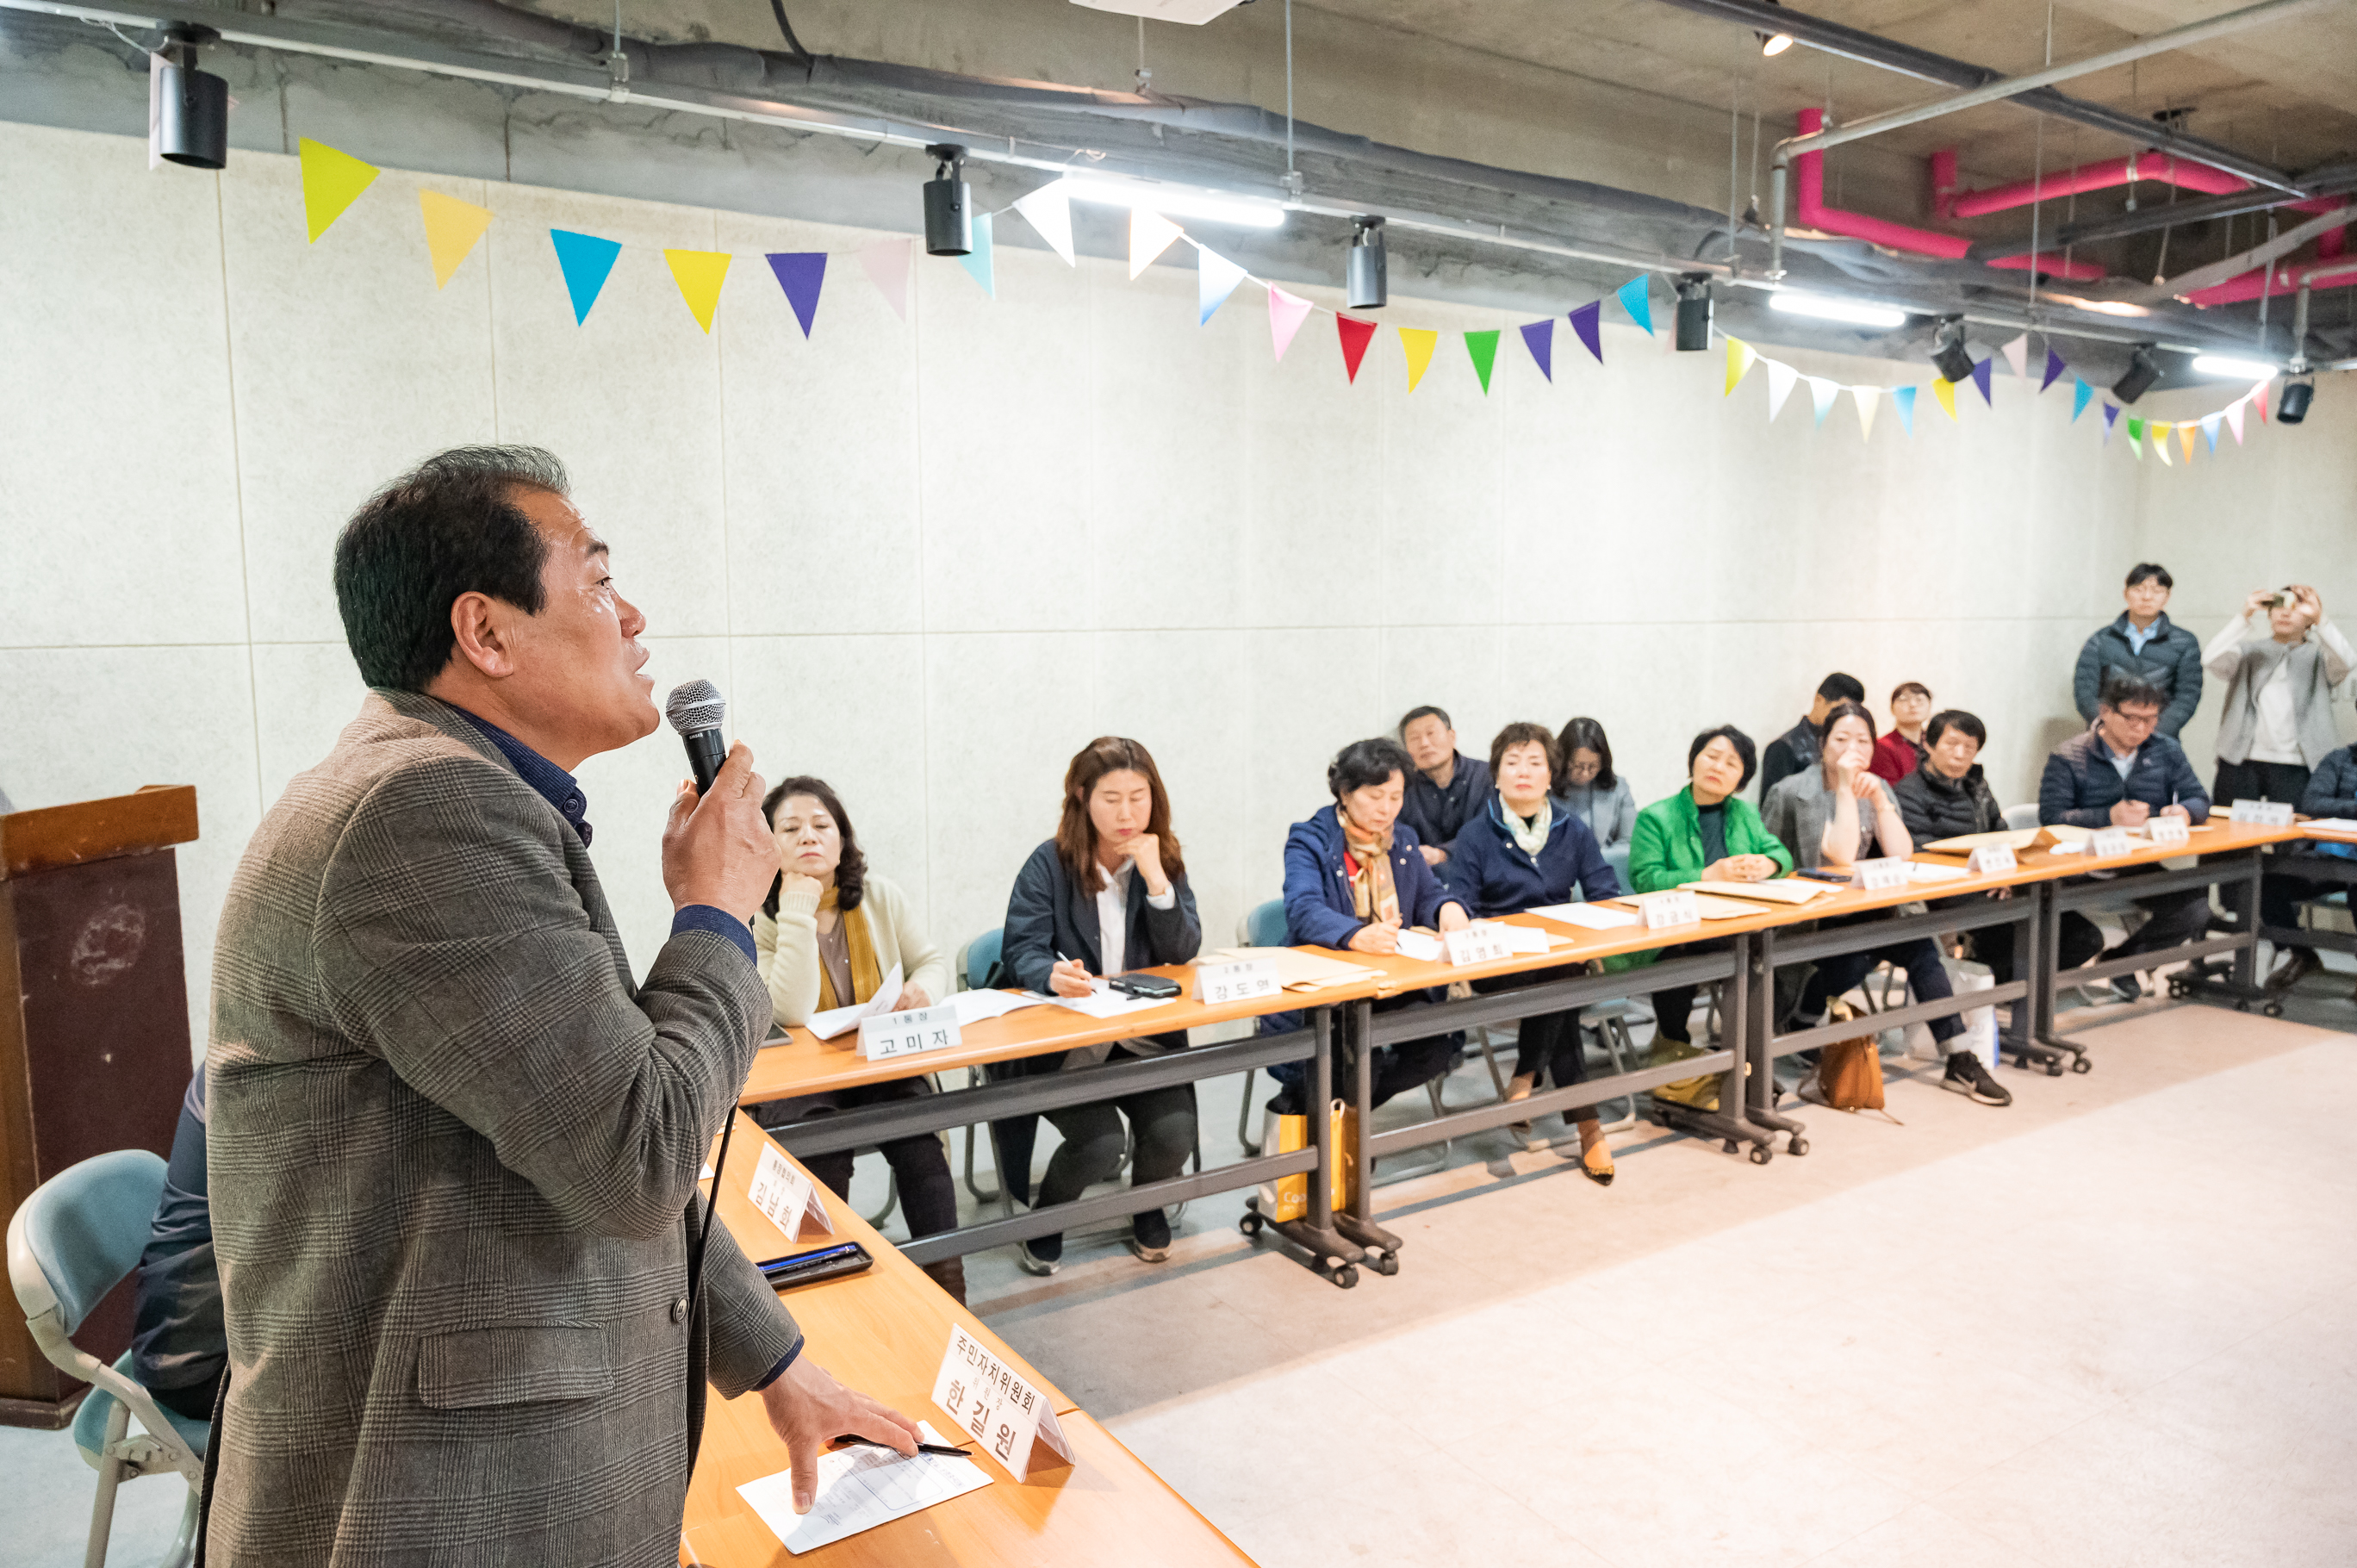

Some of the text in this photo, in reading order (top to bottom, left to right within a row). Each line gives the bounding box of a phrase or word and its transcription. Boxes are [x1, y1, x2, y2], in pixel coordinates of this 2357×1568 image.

[880, 1029, 949, 1055] 고미자
[956, 1335, 1035, 1416] 주민자치위원회
[972, 1377, 1004, 1411] 위원장
[946, 1378, 1017, 1463] 한길원
